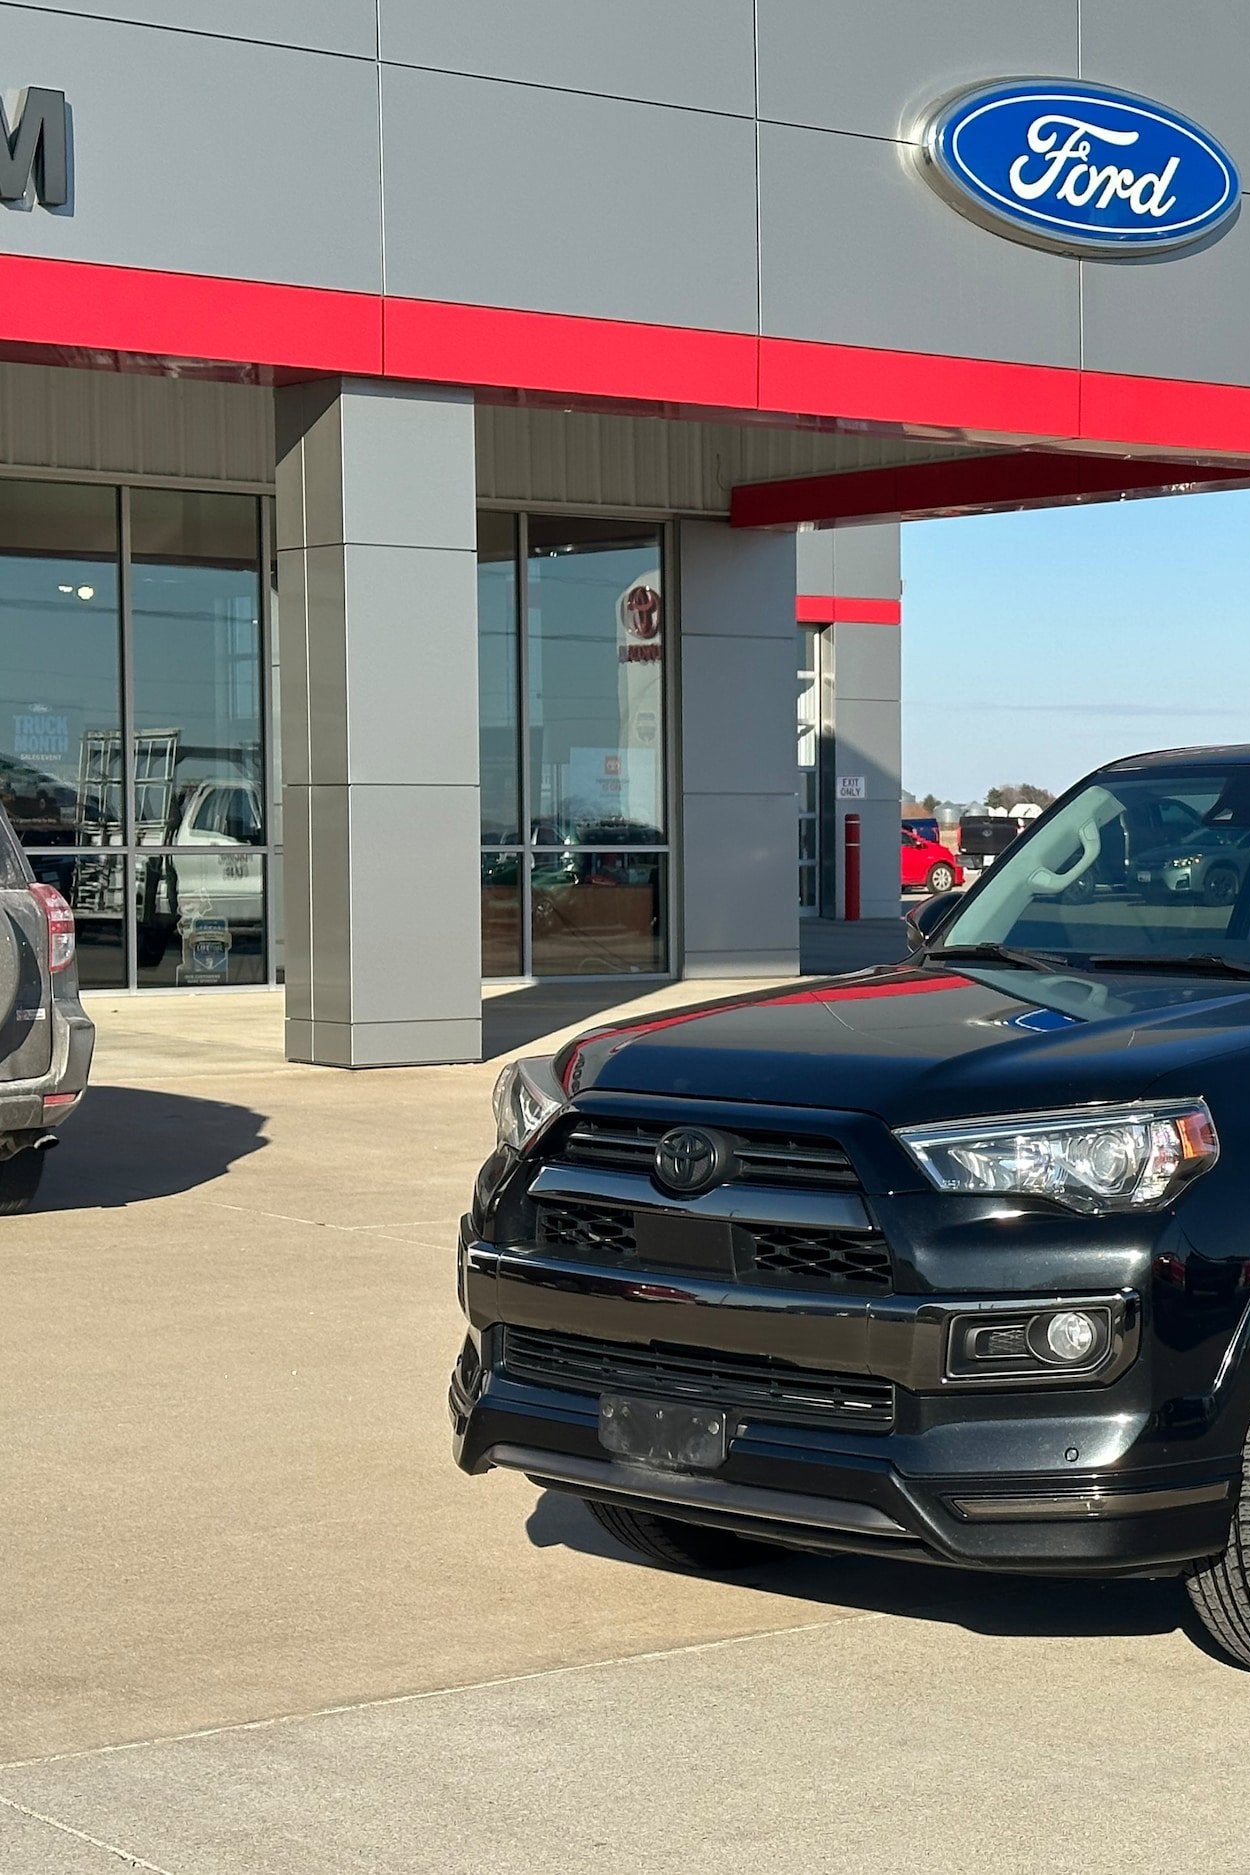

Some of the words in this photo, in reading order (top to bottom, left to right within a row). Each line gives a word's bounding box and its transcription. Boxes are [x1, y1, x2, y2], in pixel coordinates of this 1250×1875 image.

[1009, 114, 1180, 217] Ford
[13, 715, 68, 734] TRUCK
[15, 735, 68, 752] MONTH
[842, 778, 859, 787] EXIT
[840, 787, 861, 797] ONLY
